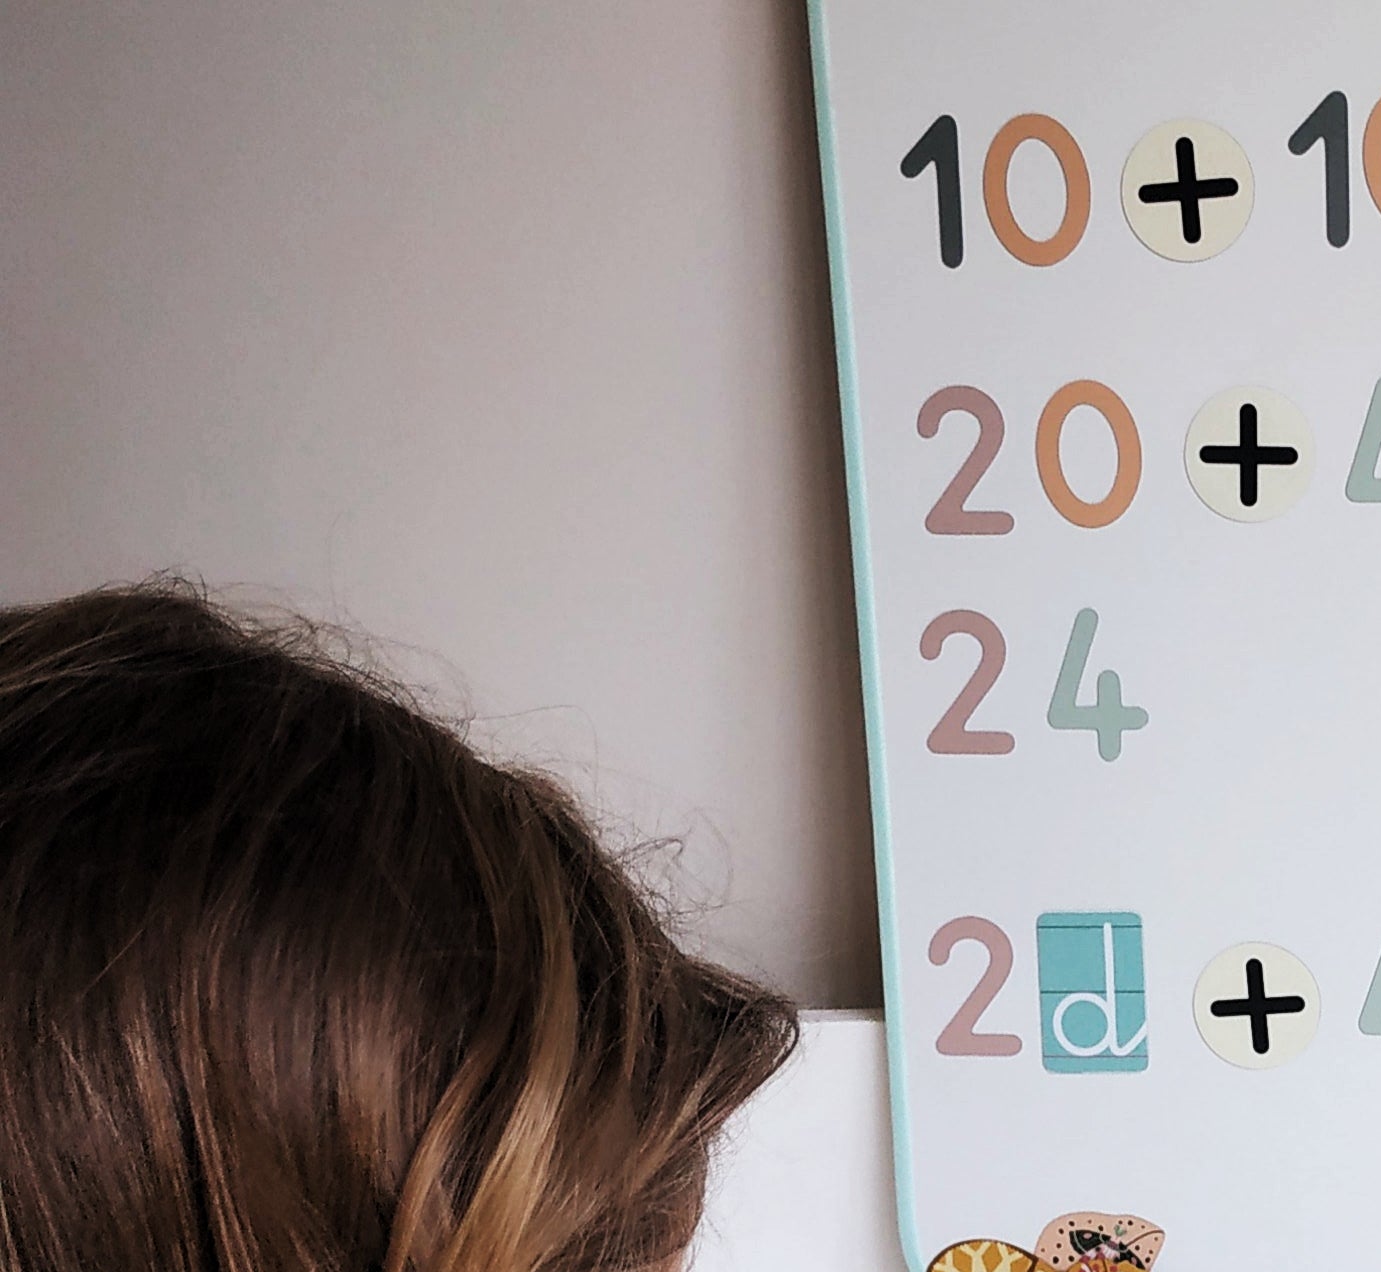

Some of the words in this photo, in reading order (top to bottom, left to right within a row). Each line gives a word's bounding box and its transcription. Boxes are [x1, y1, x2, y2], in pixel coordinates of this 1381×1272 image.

[900, 113, 1091, 268] 10
[1138, 136, 1239, 244] +
[916, 378, 1142, 535] 20
[1199, 403, 1299, 507] +
[919, 607, 1149, 762] 24
[1210, 958, 1306, 1055] +
